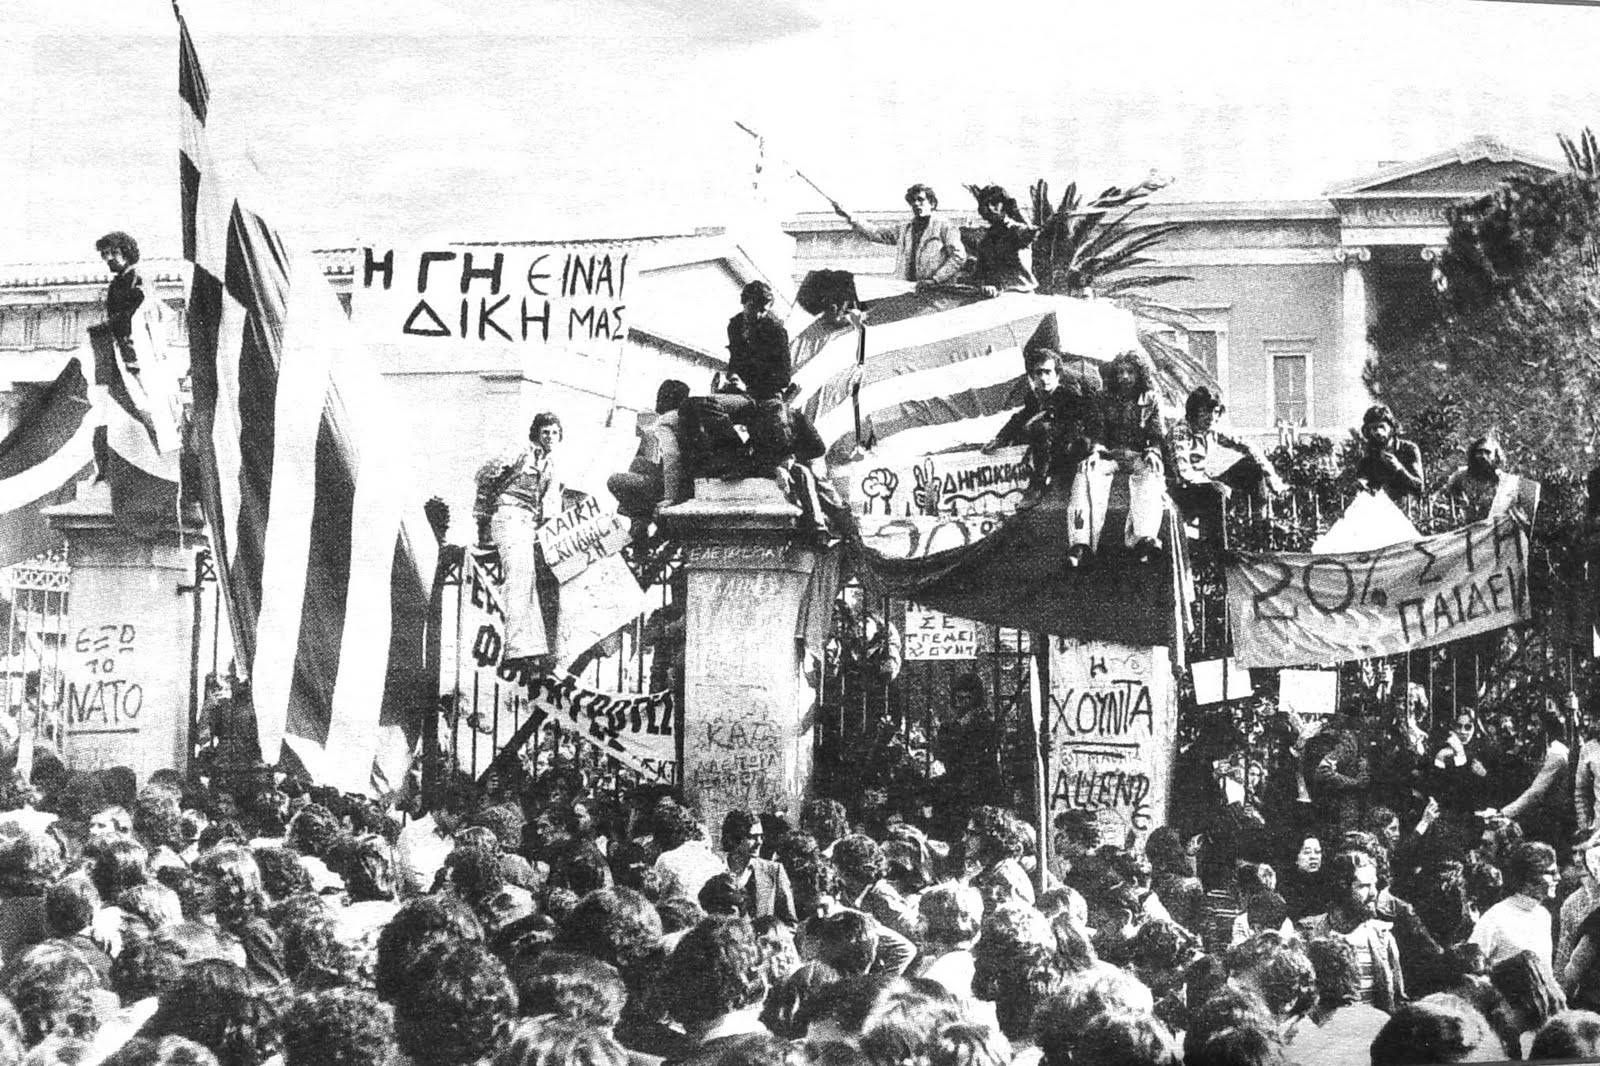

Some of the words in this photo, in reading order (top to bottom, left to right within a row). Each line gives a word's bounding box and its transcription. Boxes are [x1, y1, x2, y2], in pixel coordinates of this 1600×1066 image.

[363, 247, 394, 290] Η
[417, 251, 504, 295] ΓΗ
[527, 253, 628, 298] ΕΙΝΑΙ
[402, 294, 550, 342] ΔΙΚΗ
[568, 305, 626, 341] ΜΑΣ
[1252, 552, 1388, 620] 20%
[1050, 680, 1153, 736] ΧΟΥΝΤΑ
